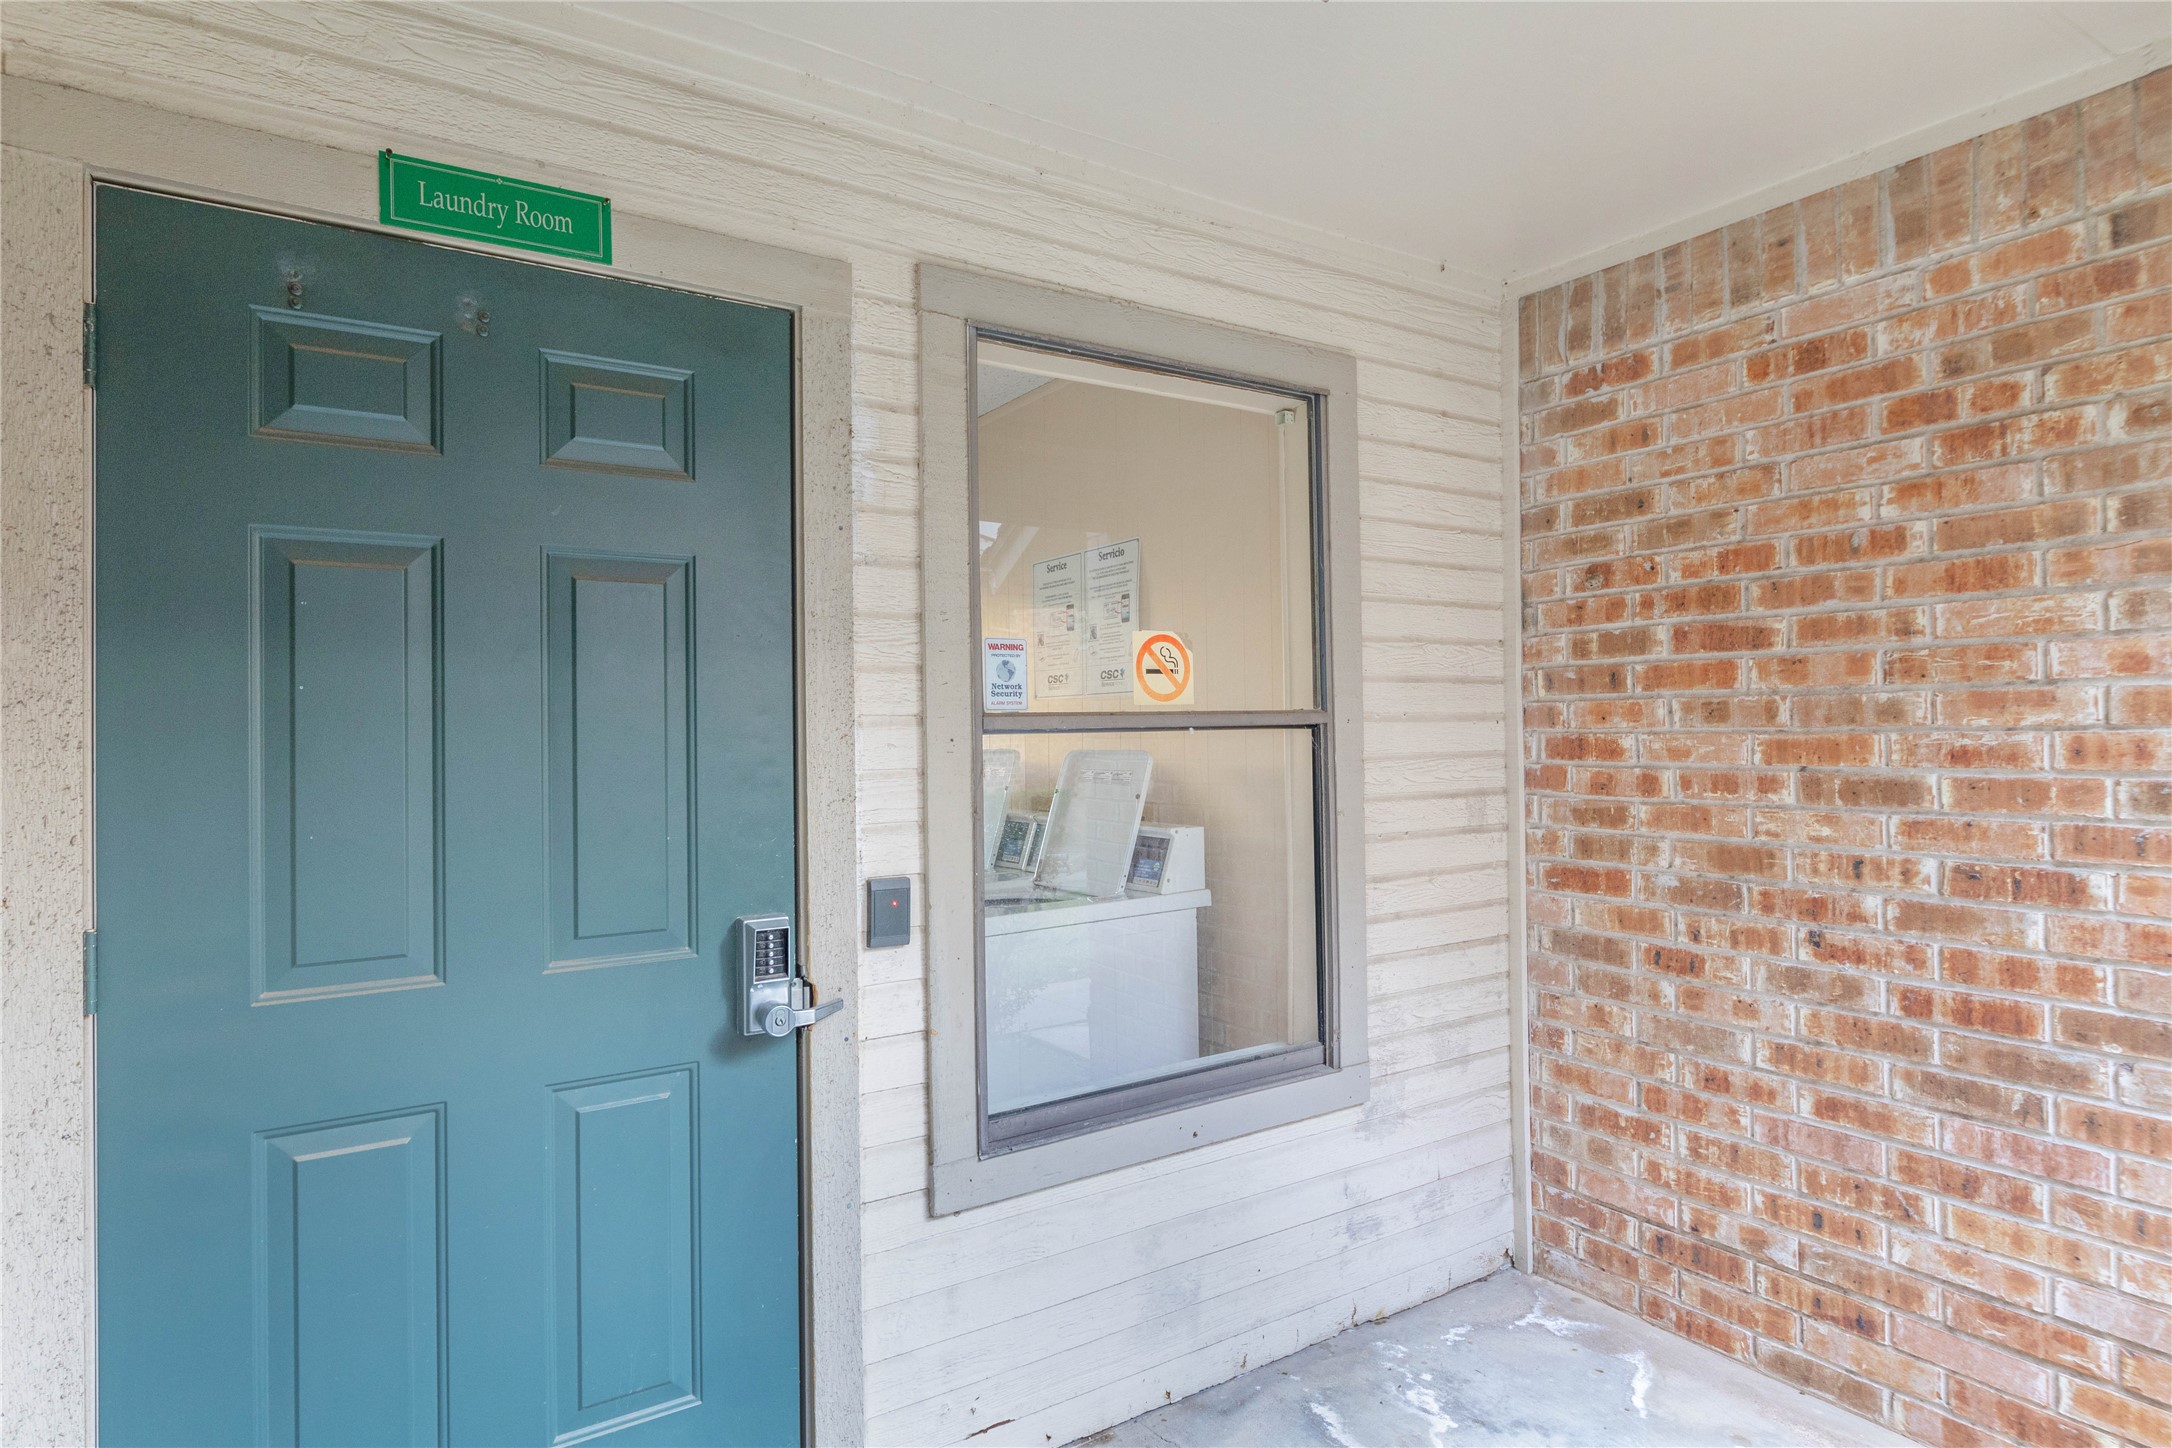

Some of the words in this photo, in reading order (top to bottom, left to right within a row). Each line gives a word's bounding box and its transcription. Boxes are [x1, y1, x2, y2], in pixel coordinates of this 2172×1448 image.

[417, 180, 509, 229] Laundry
[515, 199, 574, 234] Room
[1098, 547, 1125, 562] Servicio
[1046, 561, 1068, 574] Service
[987, 642, 1024, 651] WARNING
[1047, 674, 1064, 684] CSC
[1100, 669, 1119, 680] CSC
[990, 690, 1023, 699] Security
